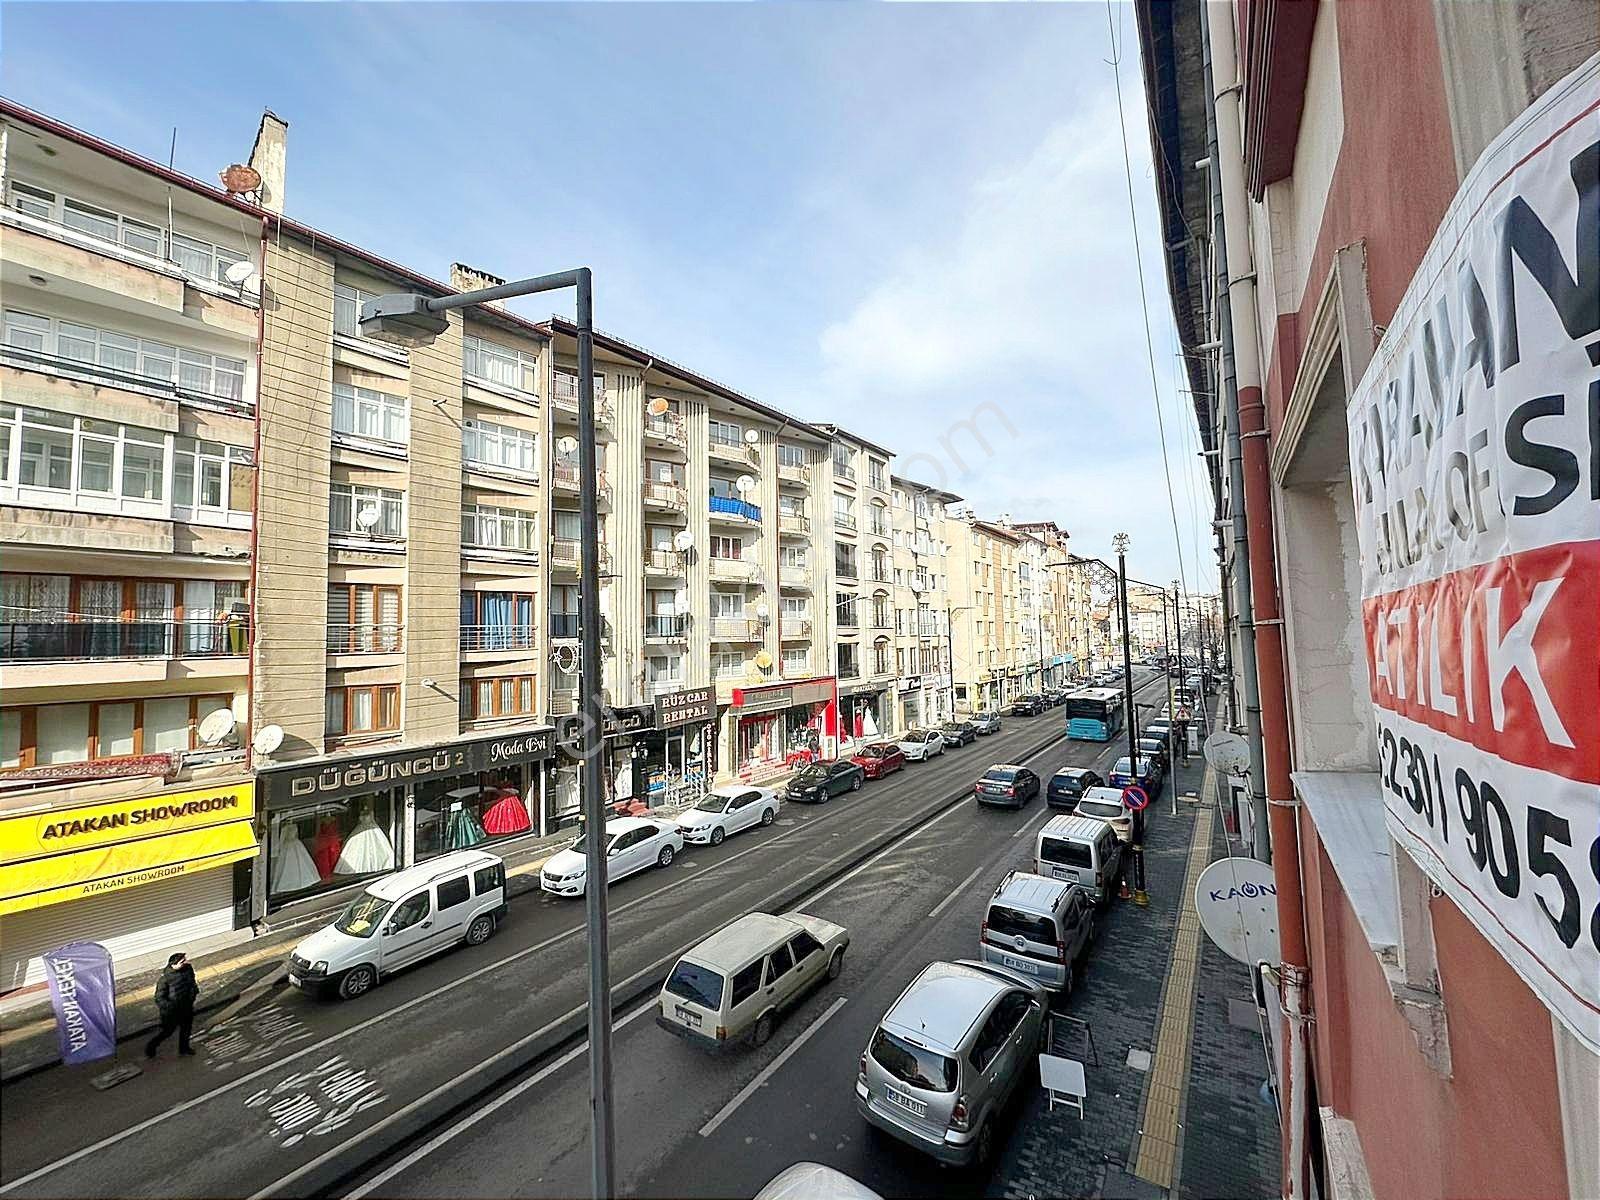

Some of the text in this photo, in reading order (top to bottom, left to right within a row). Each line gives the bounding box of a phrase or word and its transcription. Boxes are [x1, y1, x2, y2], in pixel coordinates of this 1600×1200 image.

[291, 751, 450, 798] DÜĞÜNCÜ
[490, 740, 524, 762] Moda
[42, 795, 238, 840] ATAKAN SHOWROOM
[82, 864, 186, 894] ATAKAN SHOWROOM
[1209, 881, 1278, 902] KAON
